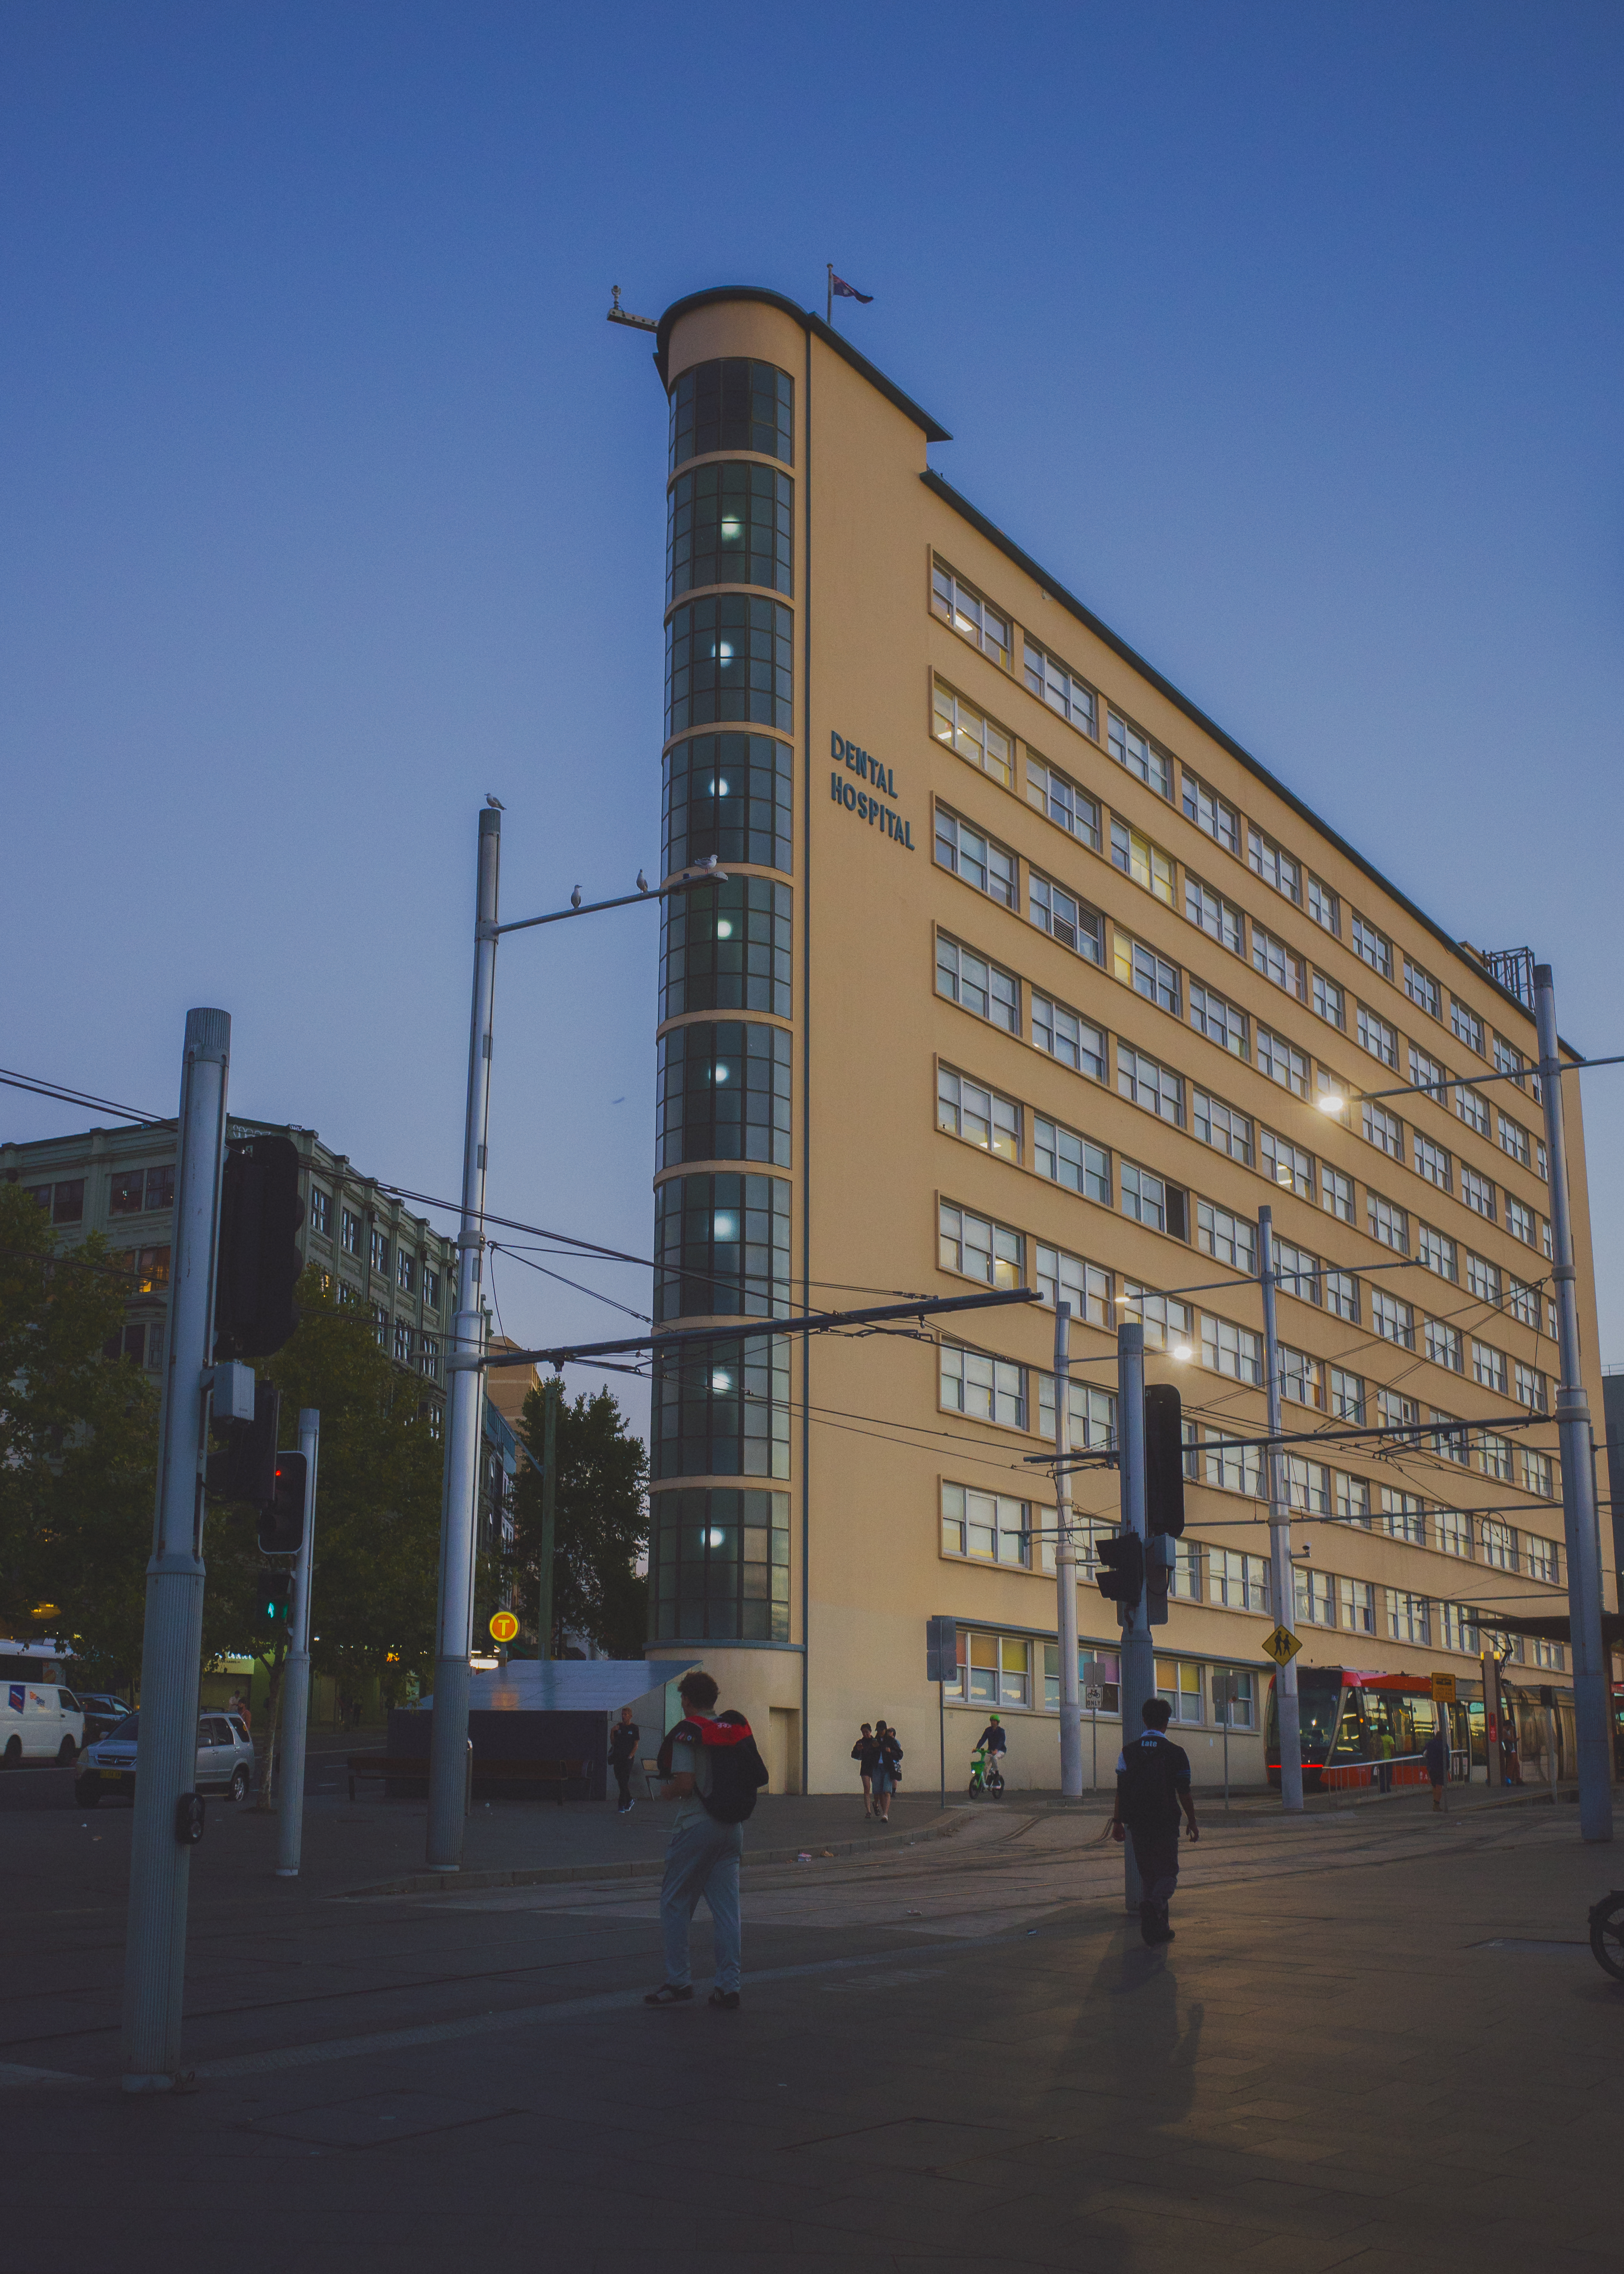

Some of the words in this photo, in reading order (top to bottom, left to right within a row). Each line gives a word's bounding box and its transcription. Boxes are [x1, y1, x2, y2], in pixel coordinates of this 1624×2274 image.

[831, 730, 898, 799] DENTAL
[831, 772, 915, 851] HOSPITAL
[498, 1619, 510, 1636] T
